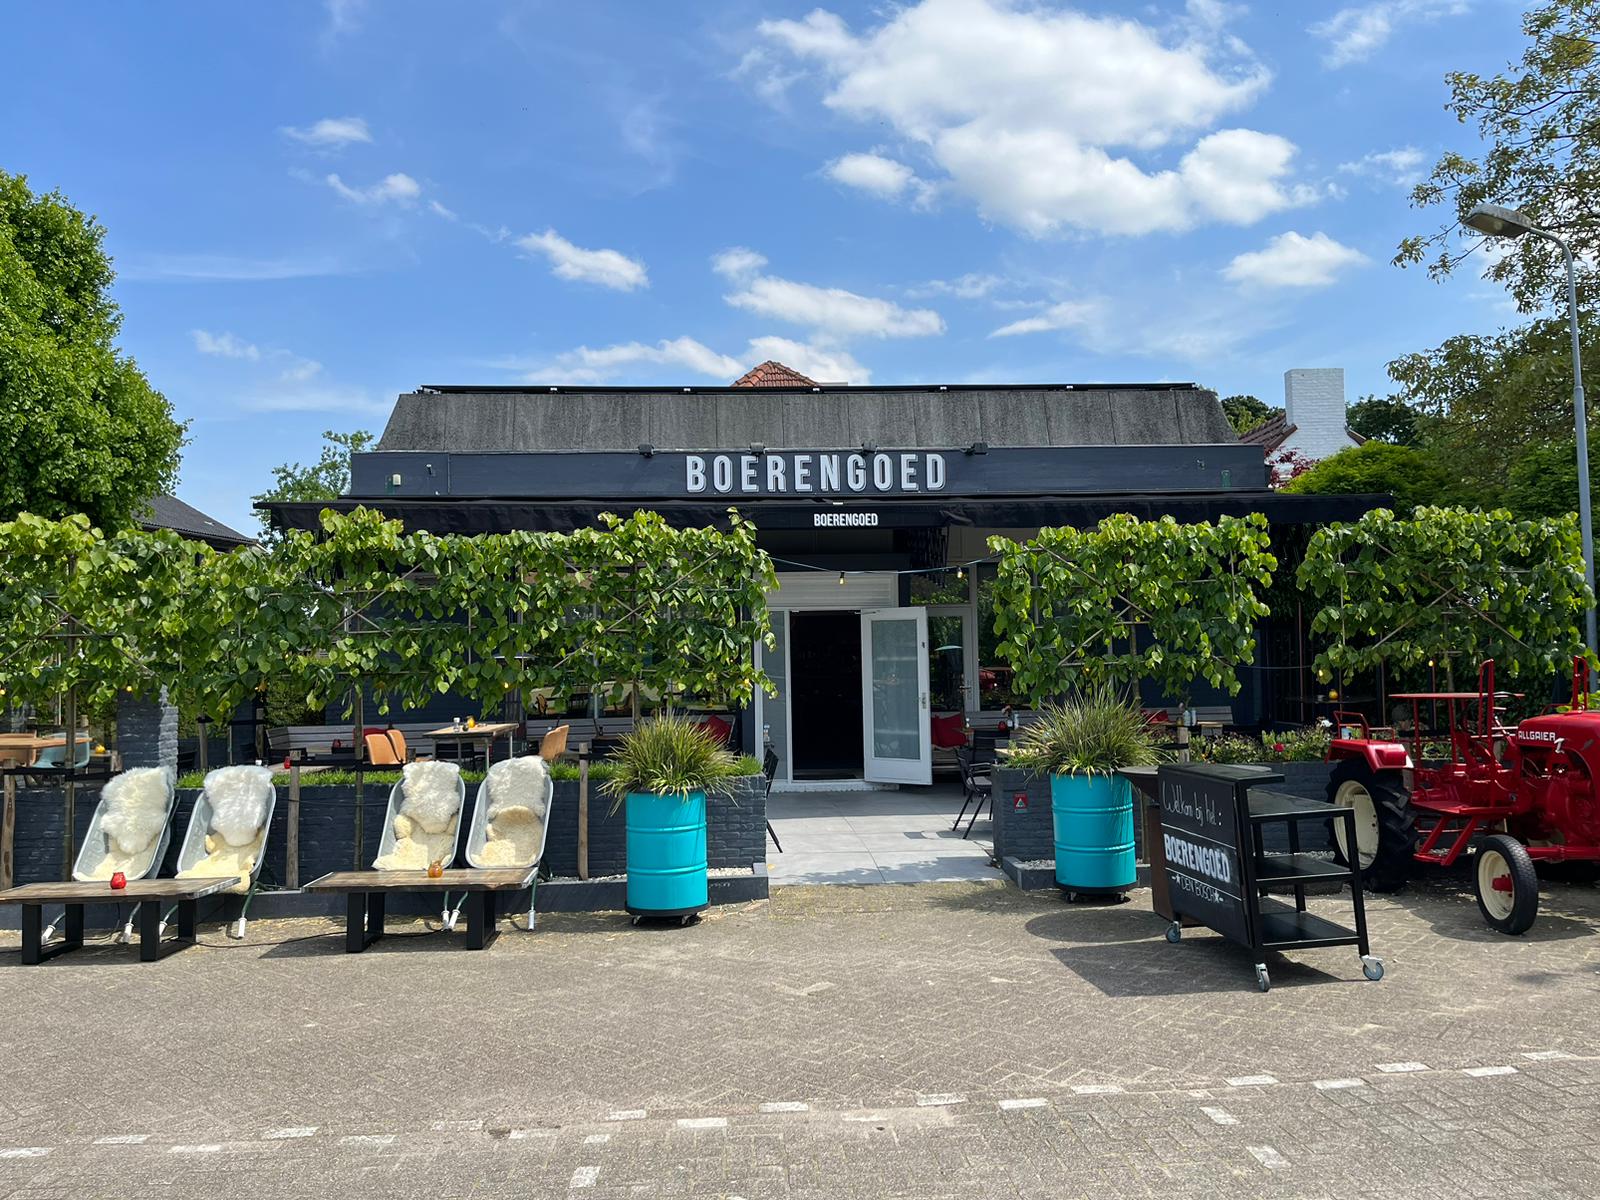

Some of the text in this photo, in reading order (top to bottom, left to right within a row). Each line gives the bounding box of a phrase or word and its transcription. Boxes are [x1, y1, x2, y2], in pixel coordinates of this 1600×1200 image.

[686, 454, 946, 493] BOERENGOED
[813, 513, 879, 527] BOERENGOED
[1518, 731, 1556, 741] ALLGAIER
[1163, 833, 1231, 883] BOERENGOED
